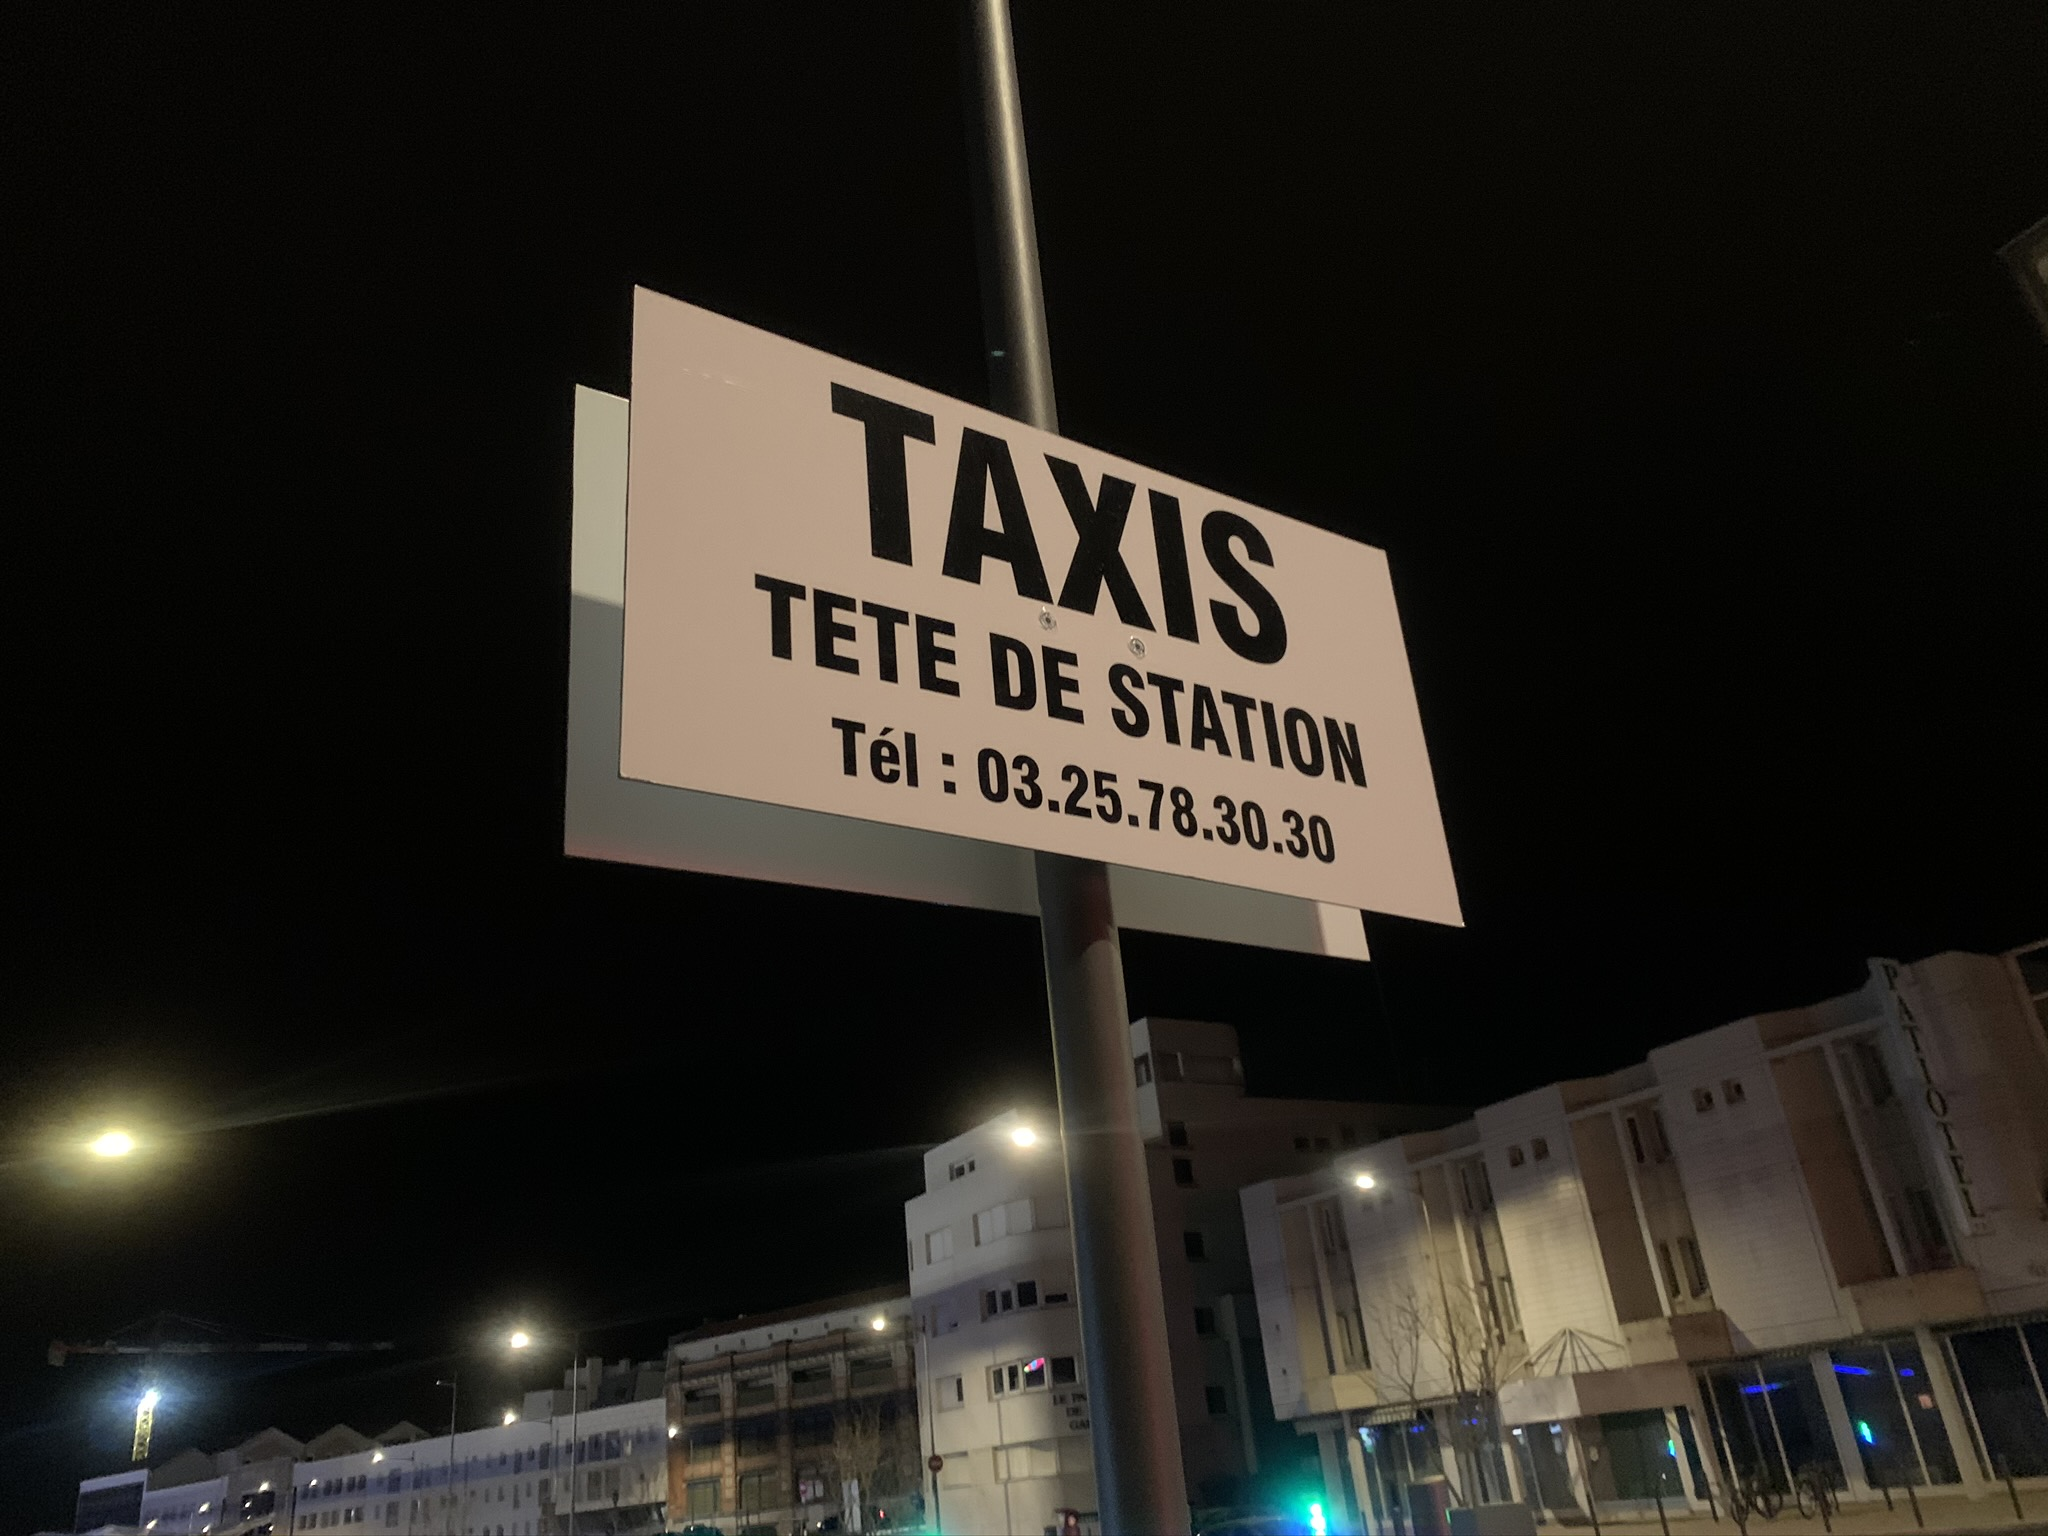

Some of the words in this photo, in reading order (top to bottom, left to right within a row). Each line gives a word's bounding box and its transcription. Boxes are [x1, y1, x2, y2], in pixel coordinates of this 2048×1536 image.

[831, 382, 1288, 665] TAXIS
[755, 572, 961, 698] TETE
[988, 631, 1085, 725] DE
[1109, 662, 1368, 789] STATION
[831, 716, 920, 789] Tél
[977, 747, 1337, 864] 03.25.78.30.30
